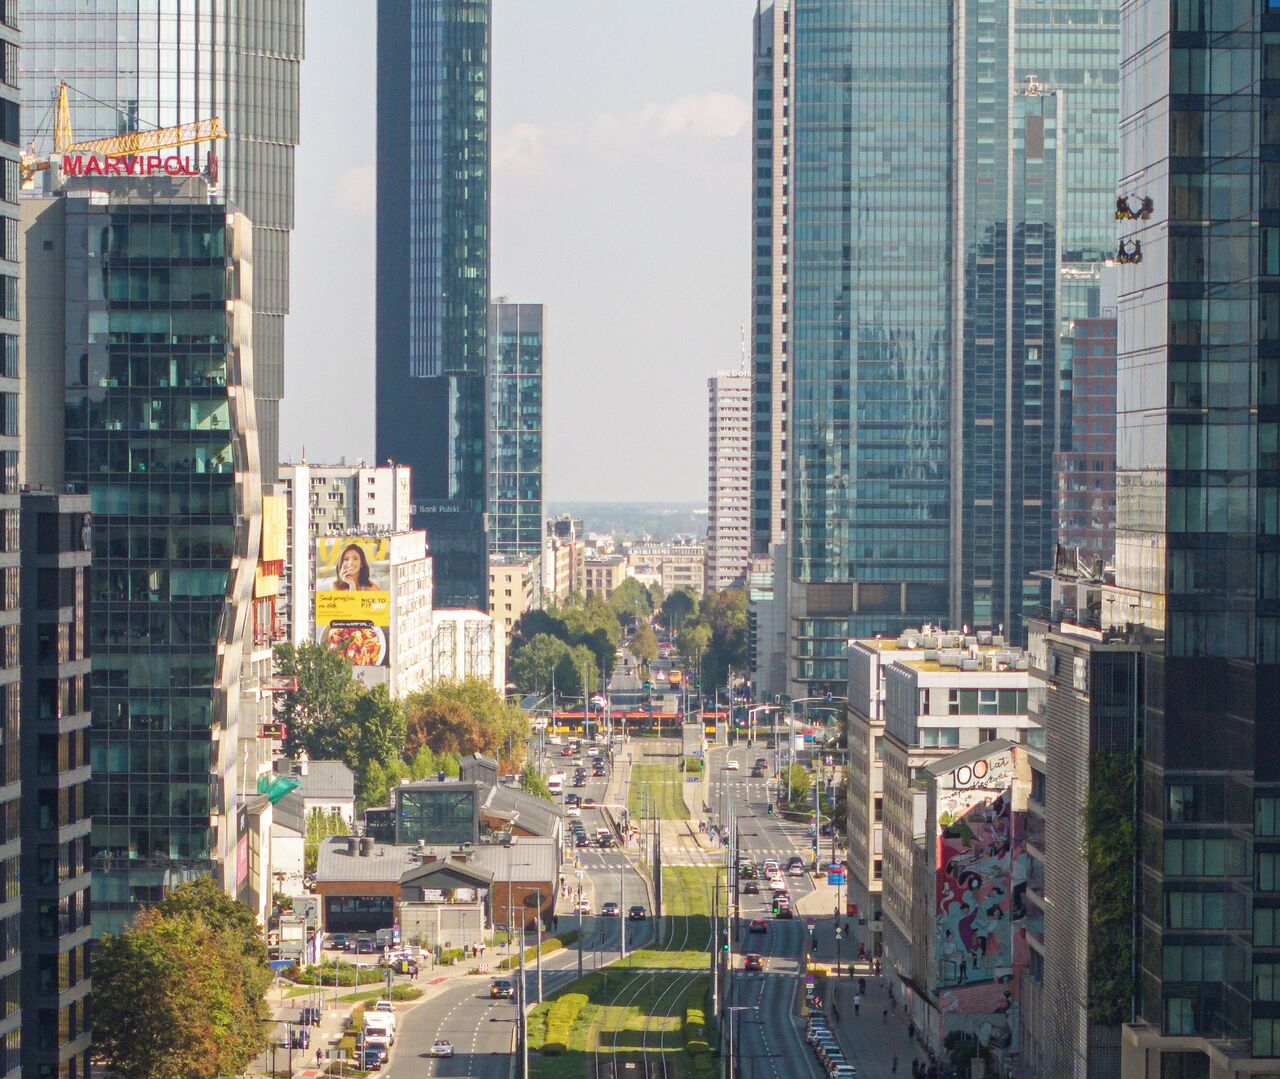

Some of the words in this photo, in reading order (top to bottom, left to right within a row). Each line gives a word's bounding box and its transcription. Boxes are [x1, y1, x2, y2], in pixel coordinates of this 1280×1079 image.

[63, 155, 200, 176] MARVIPOL
[420, 505, 437, 513] Bank
[439, 505, 460, 513] Polski
[948, 759, 989, 789] 100
[989, 756, 1009, 771] lat
